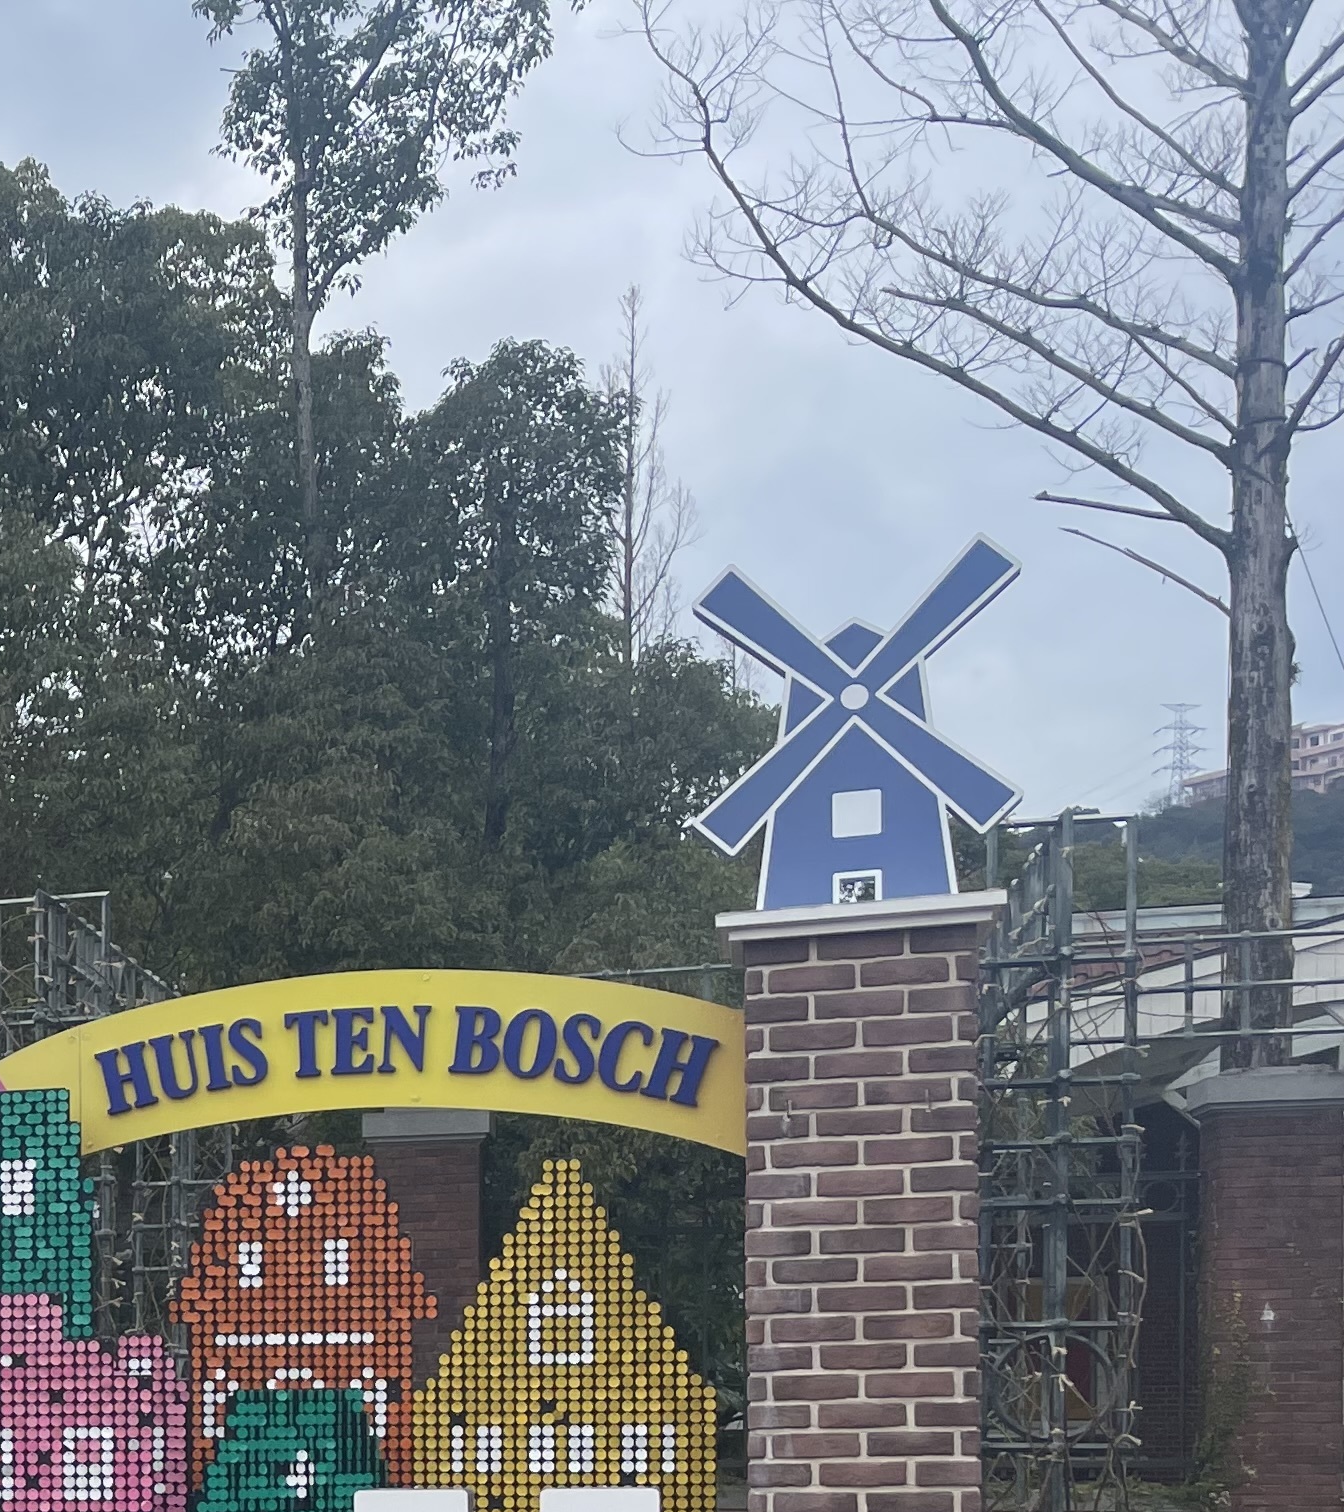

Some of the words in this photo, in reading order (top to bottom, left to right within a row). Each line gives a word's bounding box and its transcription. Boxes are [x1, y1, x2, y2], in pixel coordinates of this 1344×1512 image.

[94, 1018, 269, 1116] HUIS
[285, 1004, 433, 1079] TEN
[447, 1004, 721, 1109] BOSCH
